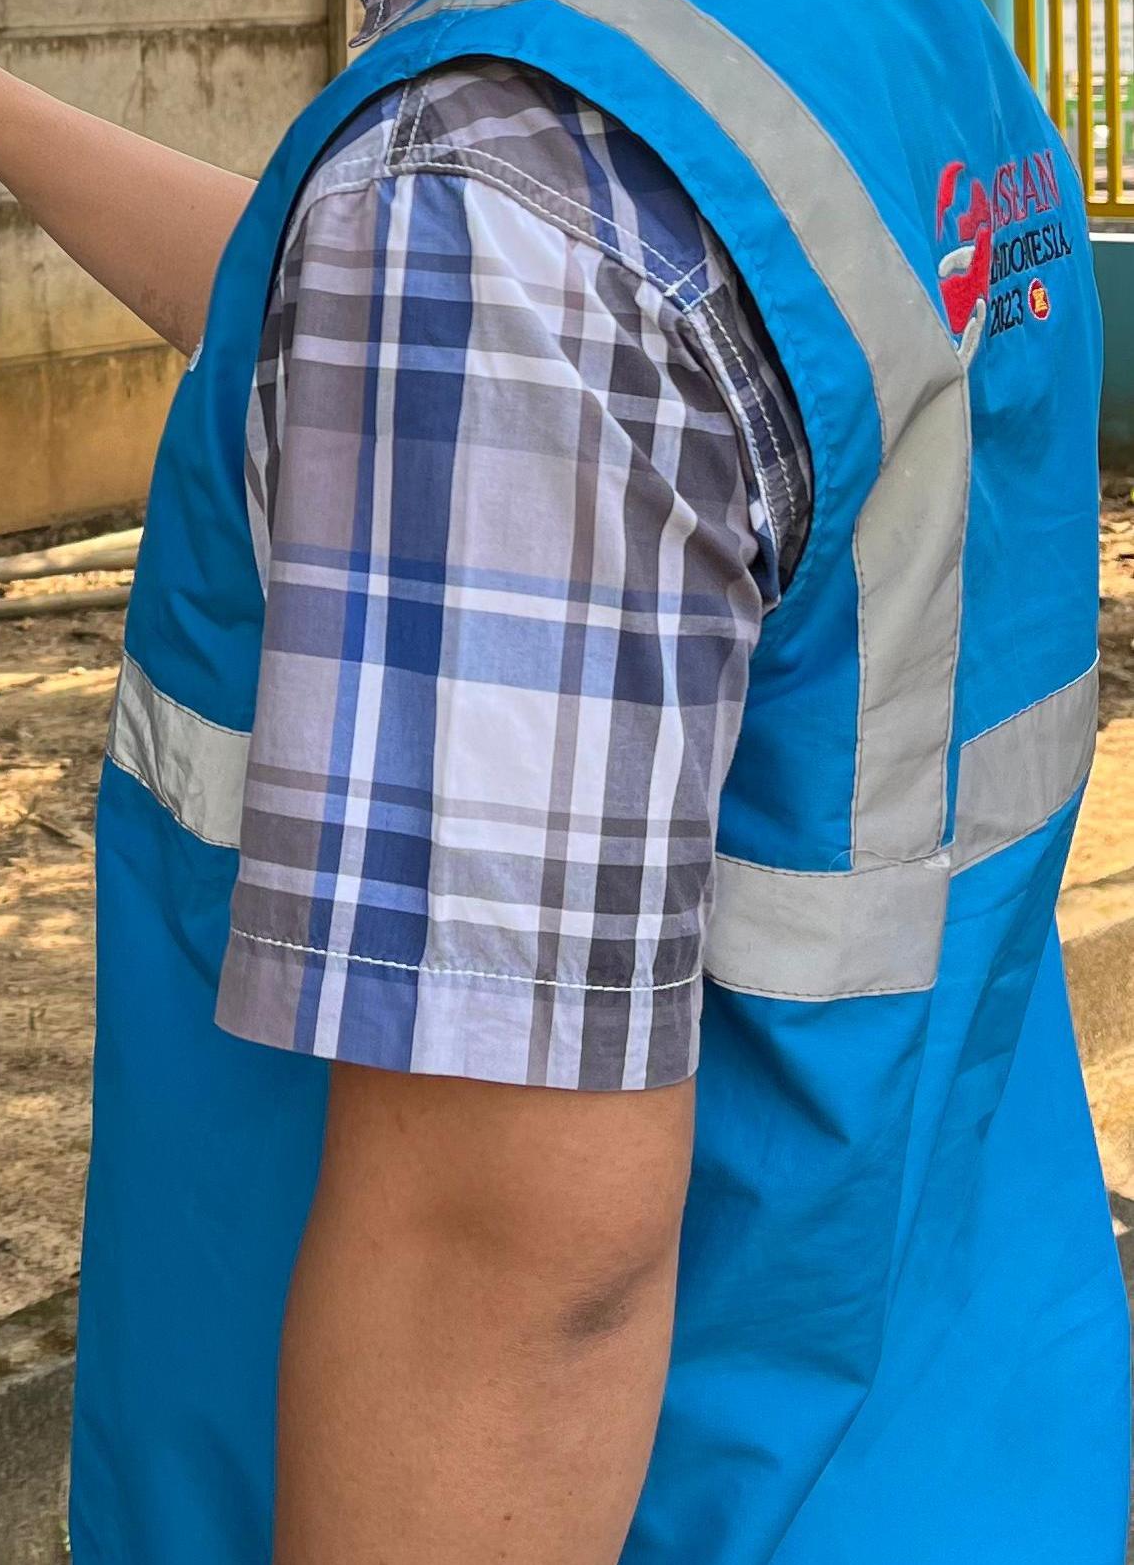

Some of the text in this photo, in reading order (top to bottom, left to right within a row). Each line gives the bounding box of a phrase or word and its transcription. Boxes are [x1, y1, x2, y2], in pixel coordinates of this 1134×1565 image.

[992, 149, 1061, 231] ASEAN
[990, 222, 1072, 285] INDONESIA
[989, 289, 1024, 338] 2023
